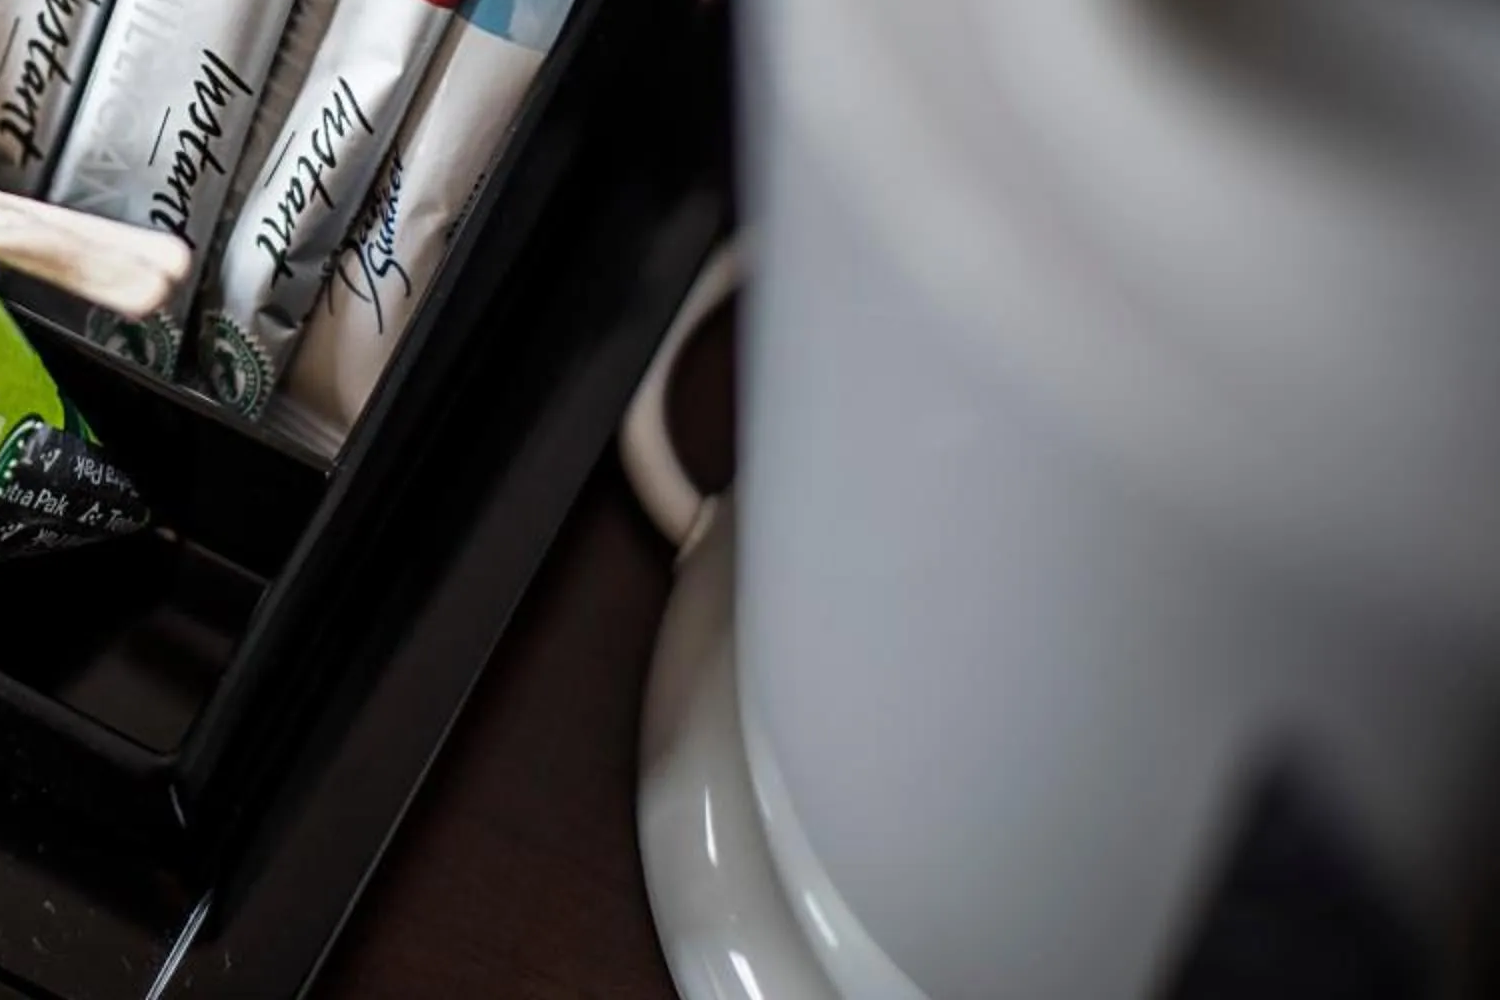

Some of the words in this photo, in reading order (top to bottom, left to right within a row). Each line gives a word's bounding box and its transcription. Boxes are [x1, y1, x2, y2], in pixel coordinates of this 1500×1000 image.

[149, 48, 254, 251] Instant
[255, 75, 373, 288] Instant
[33, 488, 68, 516] Pak
[73, 456, 104, 485] Pak
